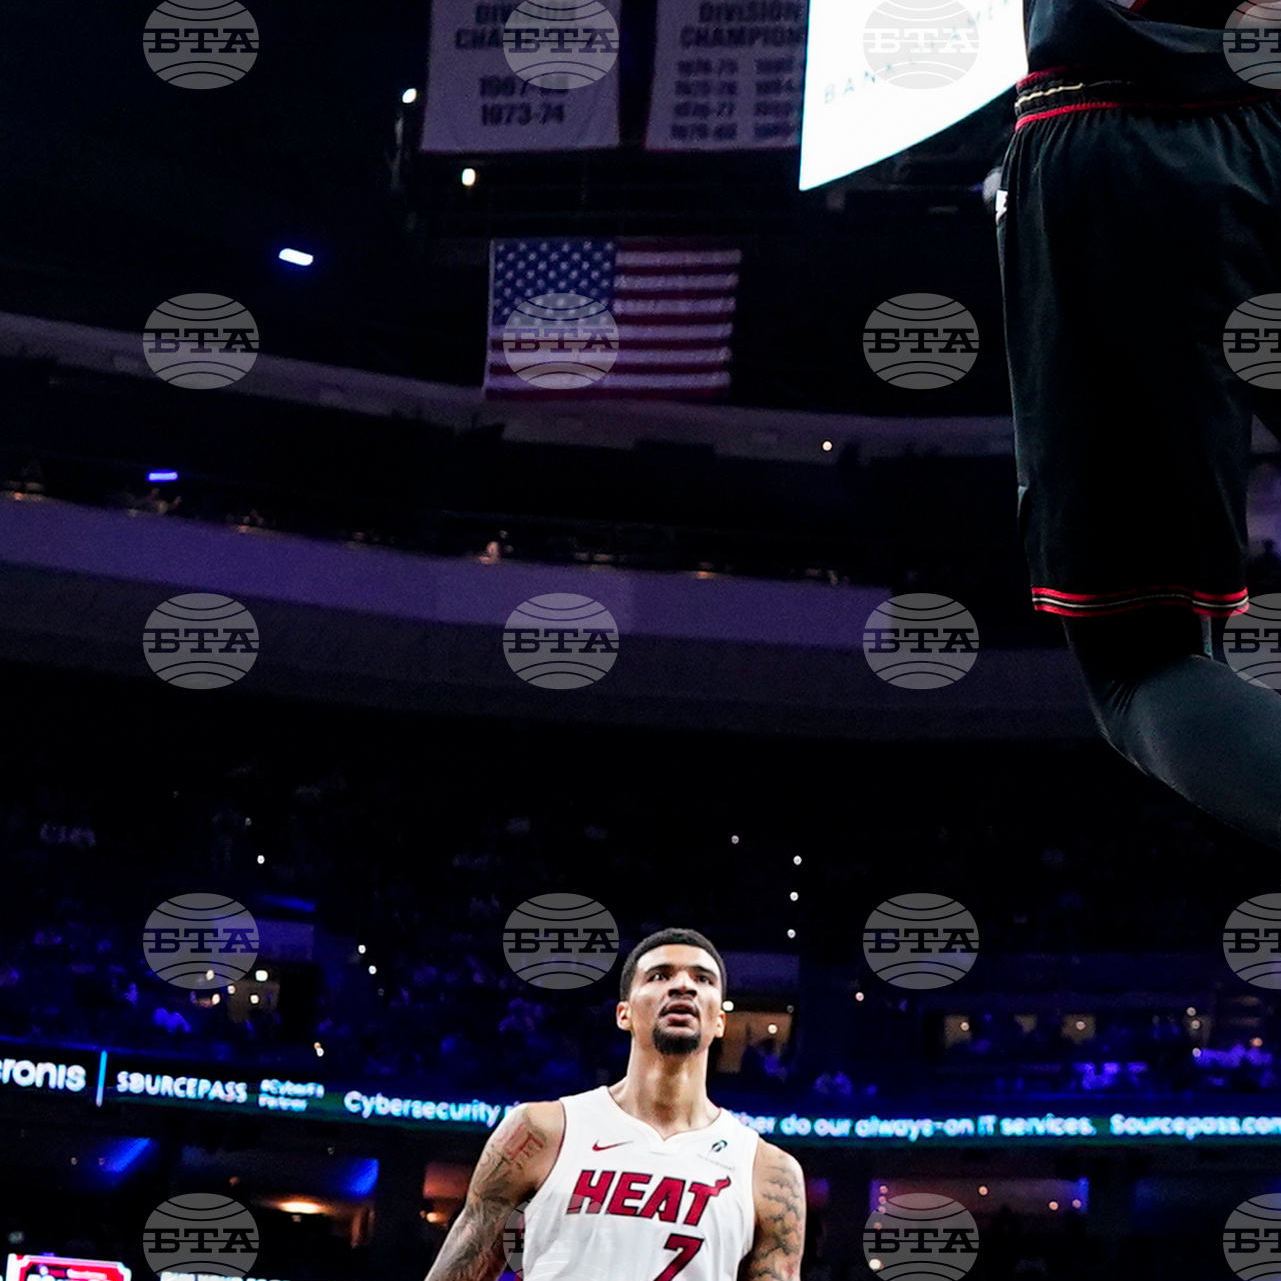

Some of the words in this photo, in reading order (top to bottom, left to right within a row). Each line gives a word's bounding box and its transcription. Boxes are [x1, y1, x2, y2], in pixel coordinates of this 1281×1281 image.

[679, 25, 806, 49] CHAMPION
[0, 1058, 87, 1092] ronis
[116, 1071, 248, 1103] SOURCEPASS
[343, 1090, 500, 1128] Cybersecurity
[779, 1112, 812, 1136] do
[813, 1117, 852, 1137] our
[854, 1115, 975, 1143] always-on
[977, 1114, 997, 1136] IT
[566, 1169, 732, 1228] HEAT
